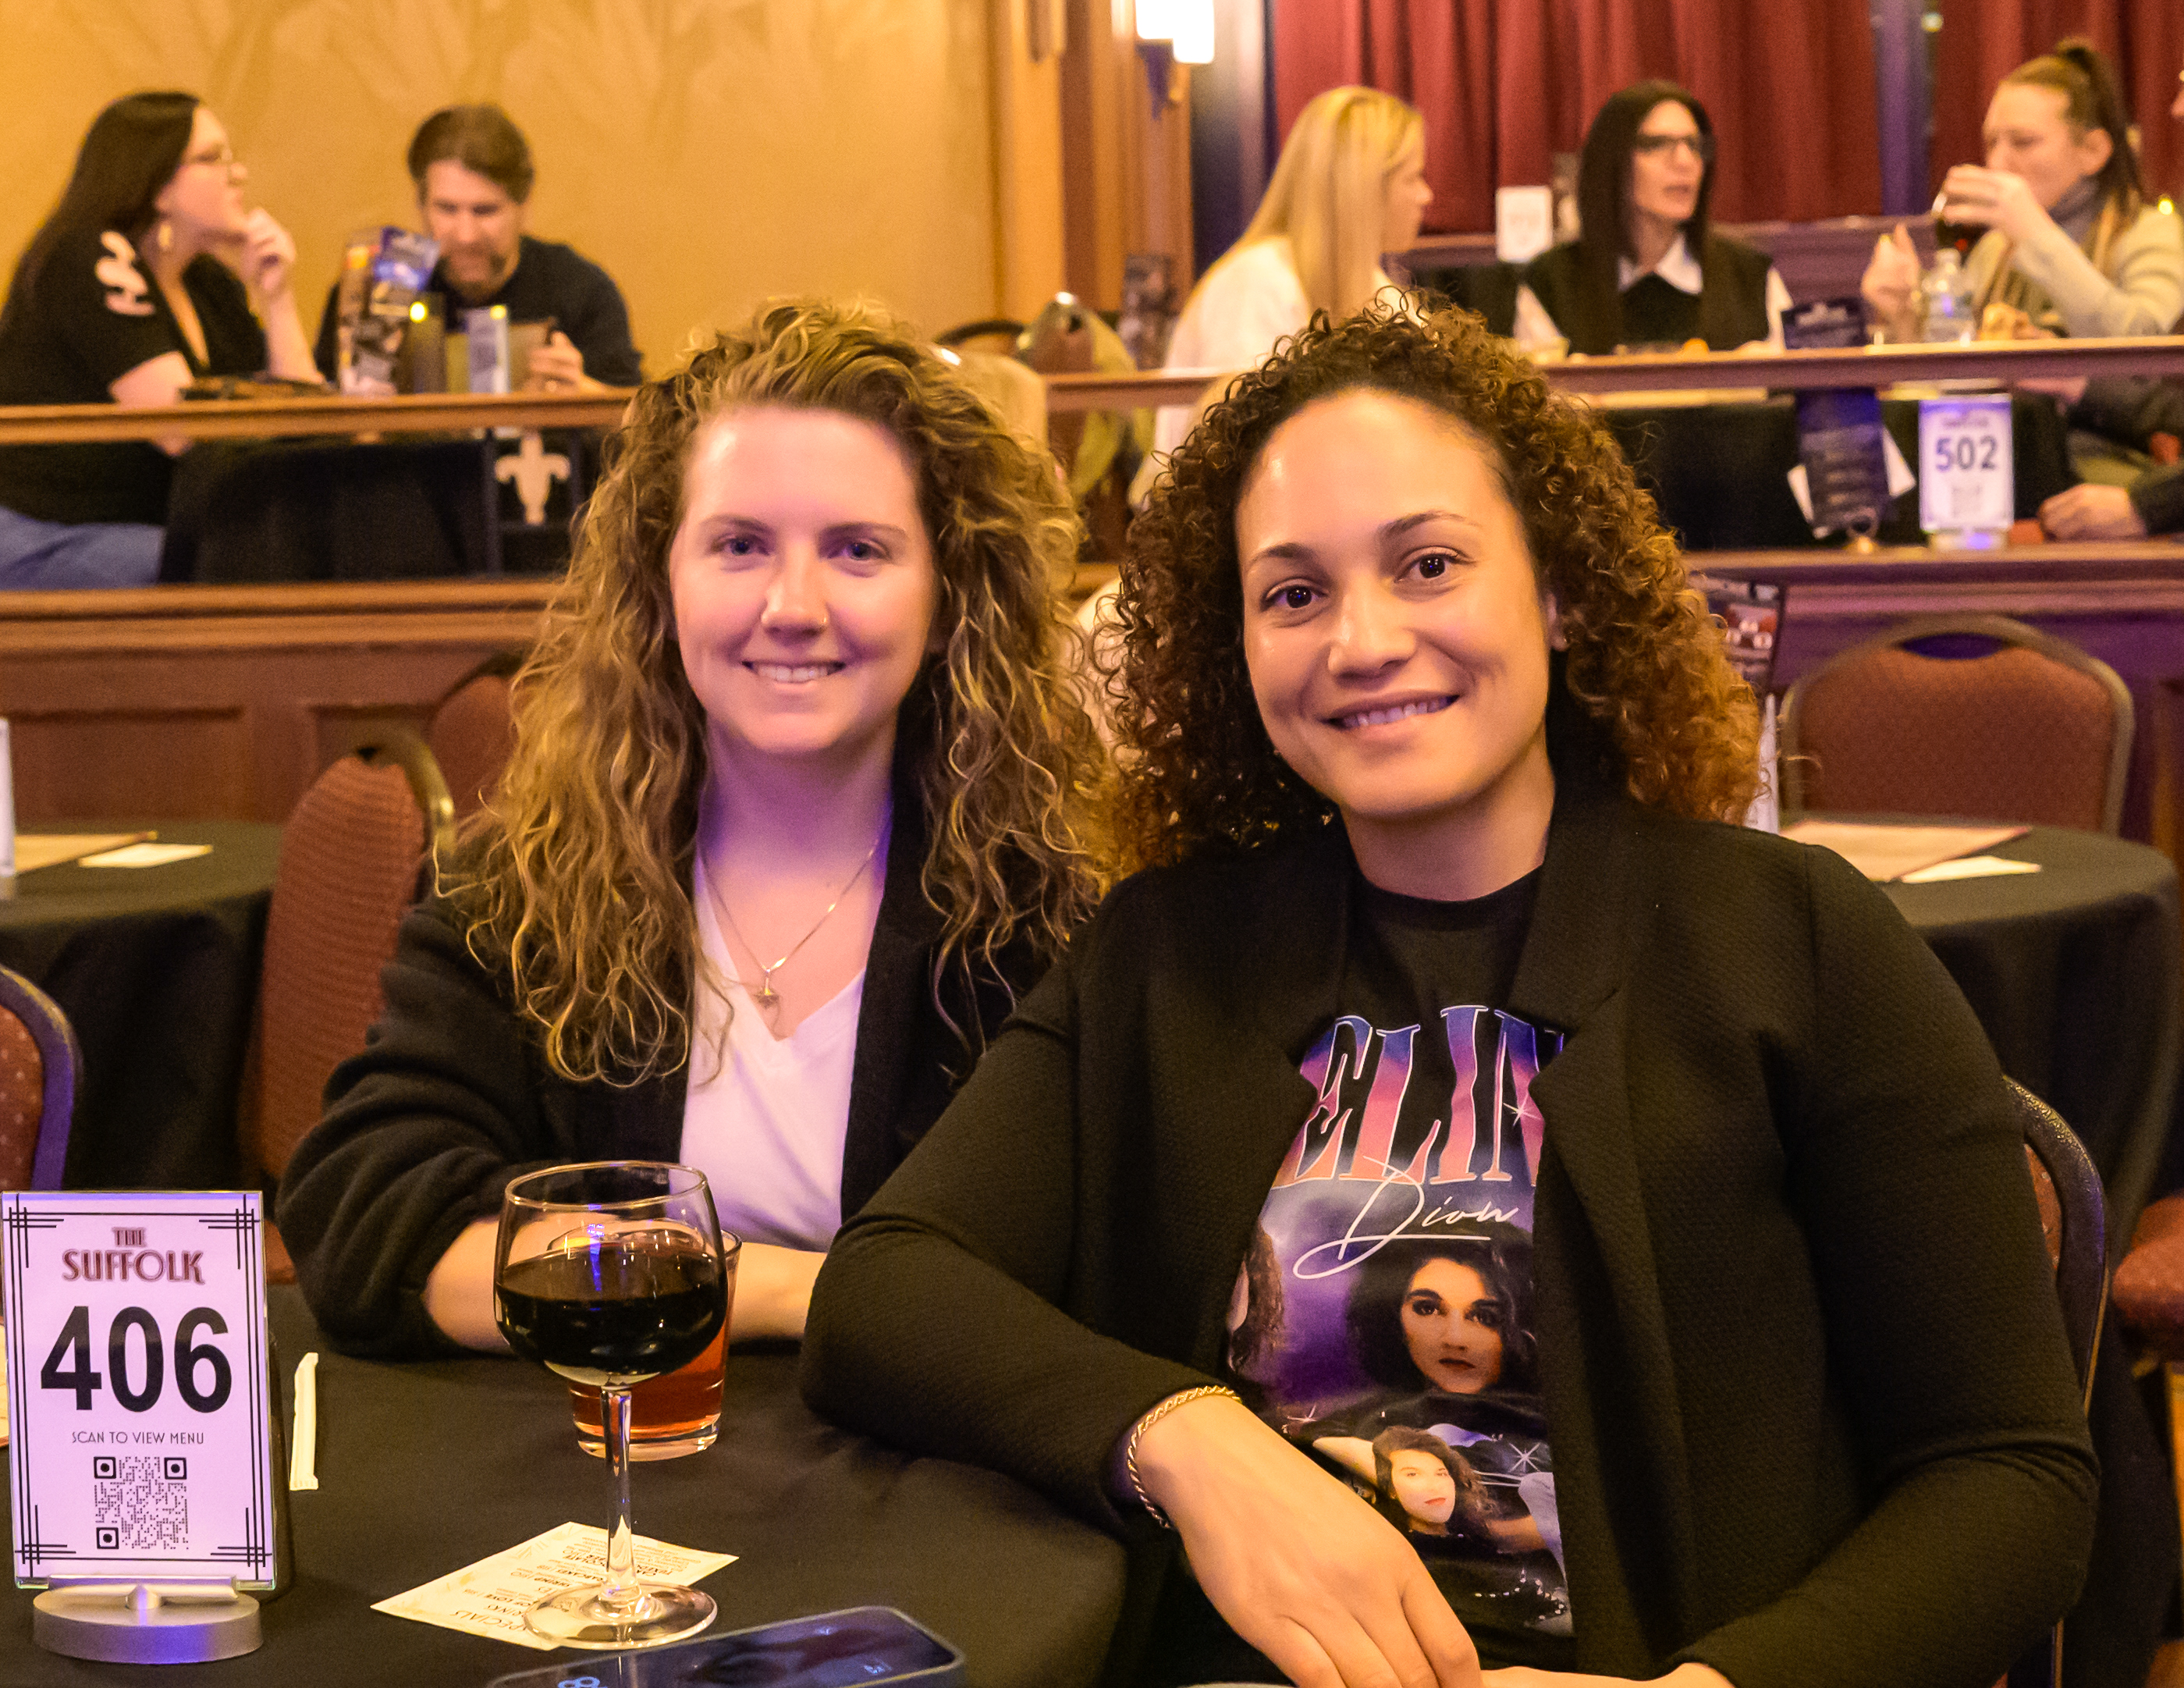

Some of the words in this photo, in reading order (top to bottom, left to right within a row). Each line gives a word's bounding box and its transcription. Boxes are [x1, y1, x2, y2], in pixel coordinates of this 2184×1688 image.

[1936, 437, 1997, 470] 502
[1271, 1004, 1564, 1189] ELIN
[1292, 1156, 1519, 1279] Dion
[113, 1228, 146, 1247] THE
[62, 1249, 205, 1285] SUFFOLK
[41, 1306, 232, 1413] 406
[72, 1431, 105, 1444] SCAN
[110, 1431, 128, 1444] TO
[133, 1431, 165, 1445] VIEW
[170, 1432, 204, 1445] MENU
